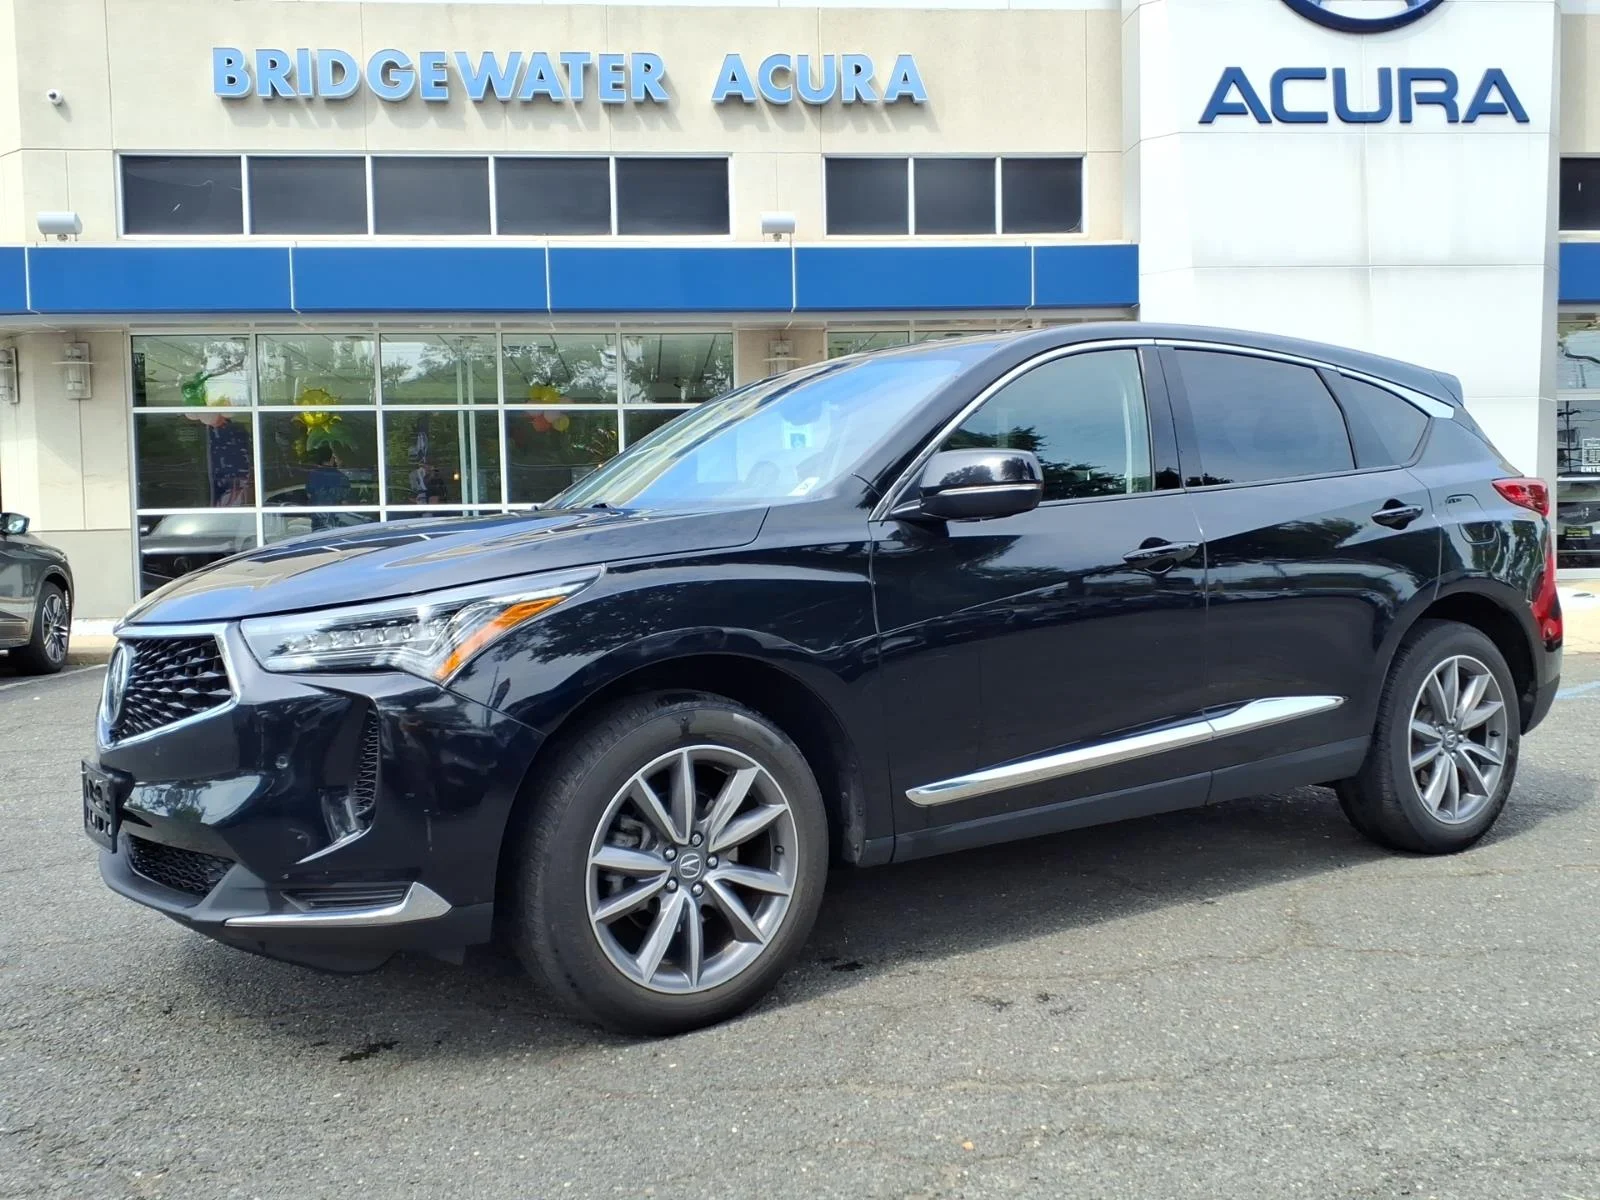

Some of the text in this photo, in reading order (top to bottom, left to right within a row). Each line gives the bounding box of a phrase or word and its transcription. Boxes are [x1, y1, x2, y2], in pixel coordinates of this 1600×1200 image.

[213, 48, 928, 105] BRIDGEWATER ACURA
[1198, 66, 1530, 124] ACURA
